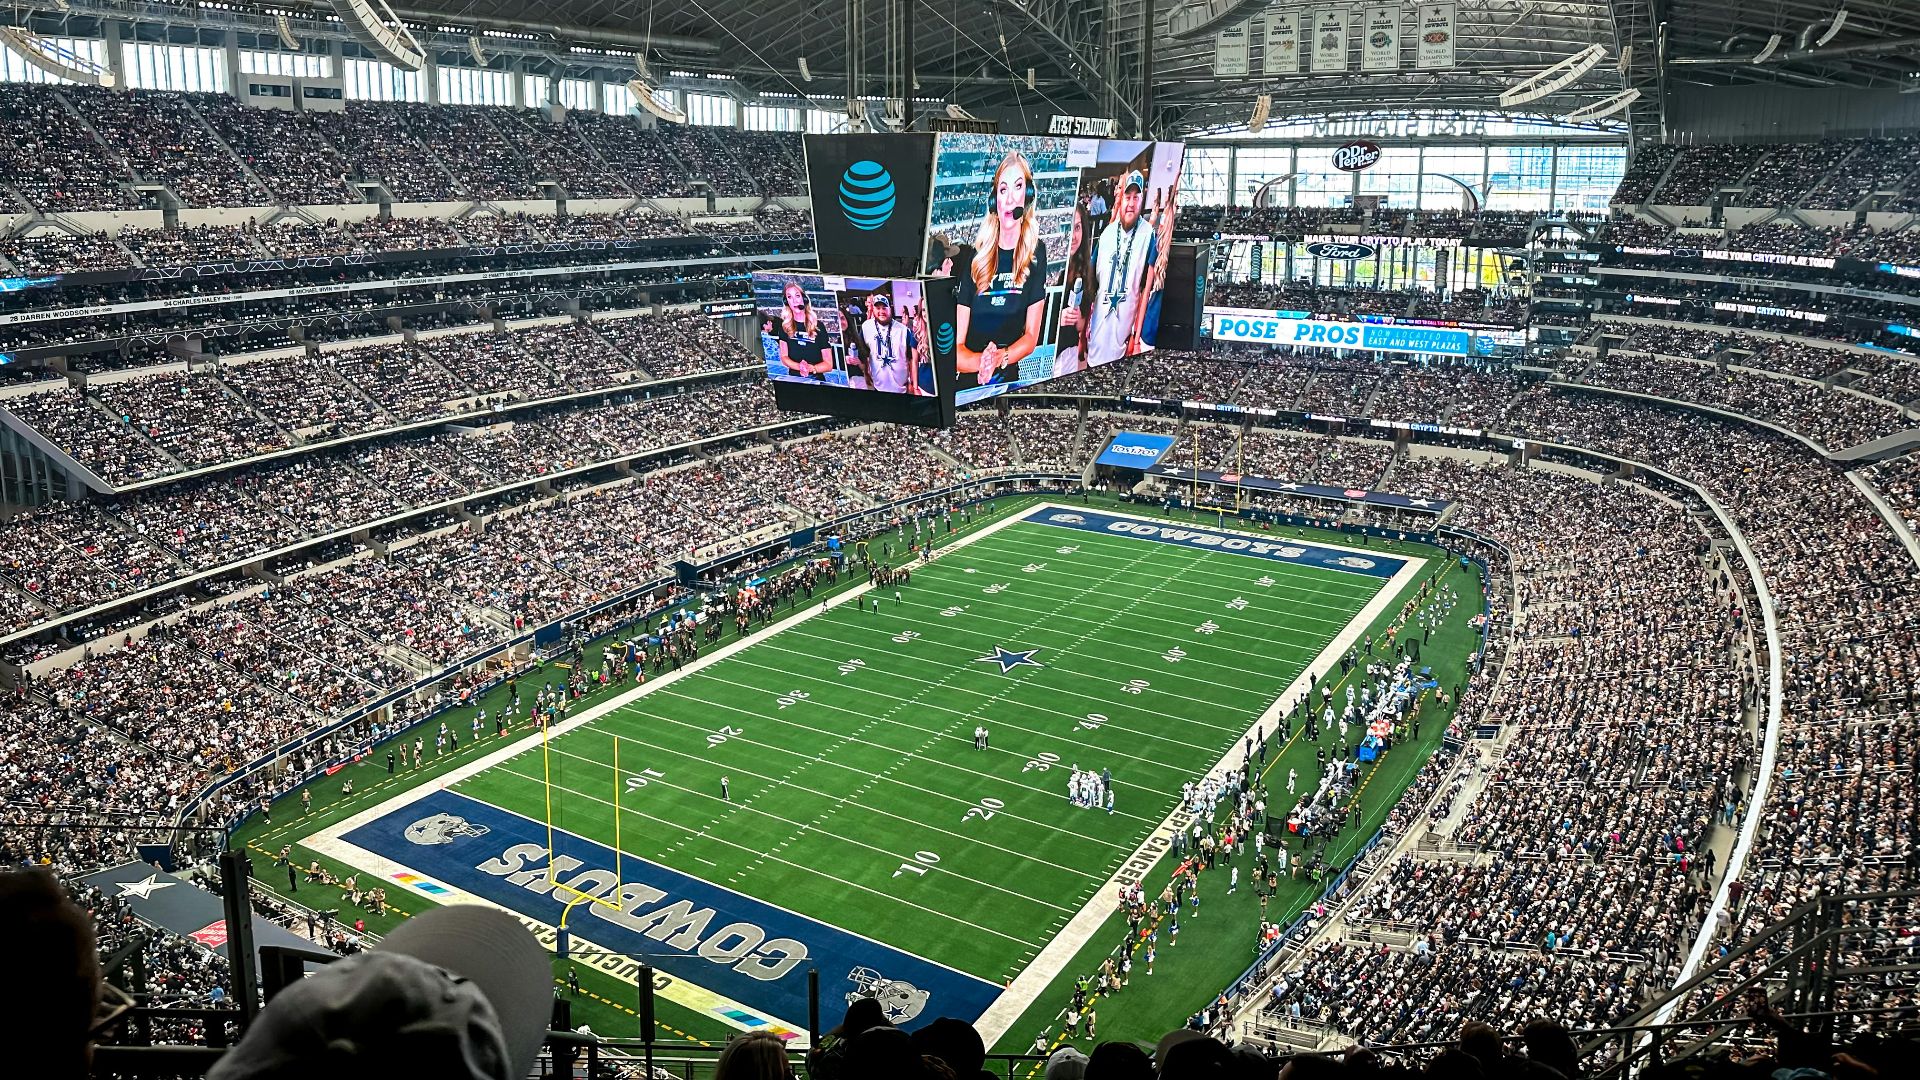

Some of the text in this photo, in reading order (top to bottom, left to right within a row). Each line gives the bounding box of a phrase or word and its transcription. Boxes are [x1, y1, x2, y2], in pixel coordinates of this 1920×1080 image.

[1049, 115, 1113, 136] AT&T STADIUM
[1338, 147, 1378, 168] Pepper
[1351, 145, 1367, 157] Dr
[1304, 235, 1462, 247] MAKE YOUR CRYPTO PLAY TODAY
[1320, 244, 1362, 258] Ford
[1703, 250, 1836, 269] MAKE YOUR CRYPTO PLAY TODAY
[172, 298, 201, 306] CHARLES
[201, 296, 221, 304] HALEY
[711, 303, 755, 312] Blockchain.com
[20, 312, 51, 321] DARREN
[53, 309, 89, 318] WOODSON
[1737, 303, 1756, 312] YOUR
[1757, 306, 1786, 317] CRYPTO
[1786, 309, 1804, 319] PLAY
[1218, 319, 1360, 345] POSE PROS
[1370, 329, 1390, 337] NOW
[1396, 331, 1441, 341] LOCATED
[1368, 337, 1461, 350] EAST AND WEST PLAZAS
[1216, 404, 1240, 412] CRYPTO
[1410, 423, 1438, 432] CRYPTO
[1107, 521, 1307, 558] COWBOYS
[940, 605, 964, 617] 40
[891, 630, 921, 643] 50
[1161, 649, 1187, 663] 40
[838, 658, 866, 674] 40
[1120, 679, 1151, 695] 50
[779, 690, 810, 707] 30
[1078, 713, 1109, 730] 40
[707, 725, 744, 745] 20
[1029, 752, 1061, 772] 30
[625, 767, 666, 789] 10
[967, 797, 1005, 821] 20
[899, 850, 941, 877] 10
[1114, 836, 1171, 888] CANCER
[474, 843, 809, 981] COWBOYS
[569, 939, 673, 991] CUCIAL
